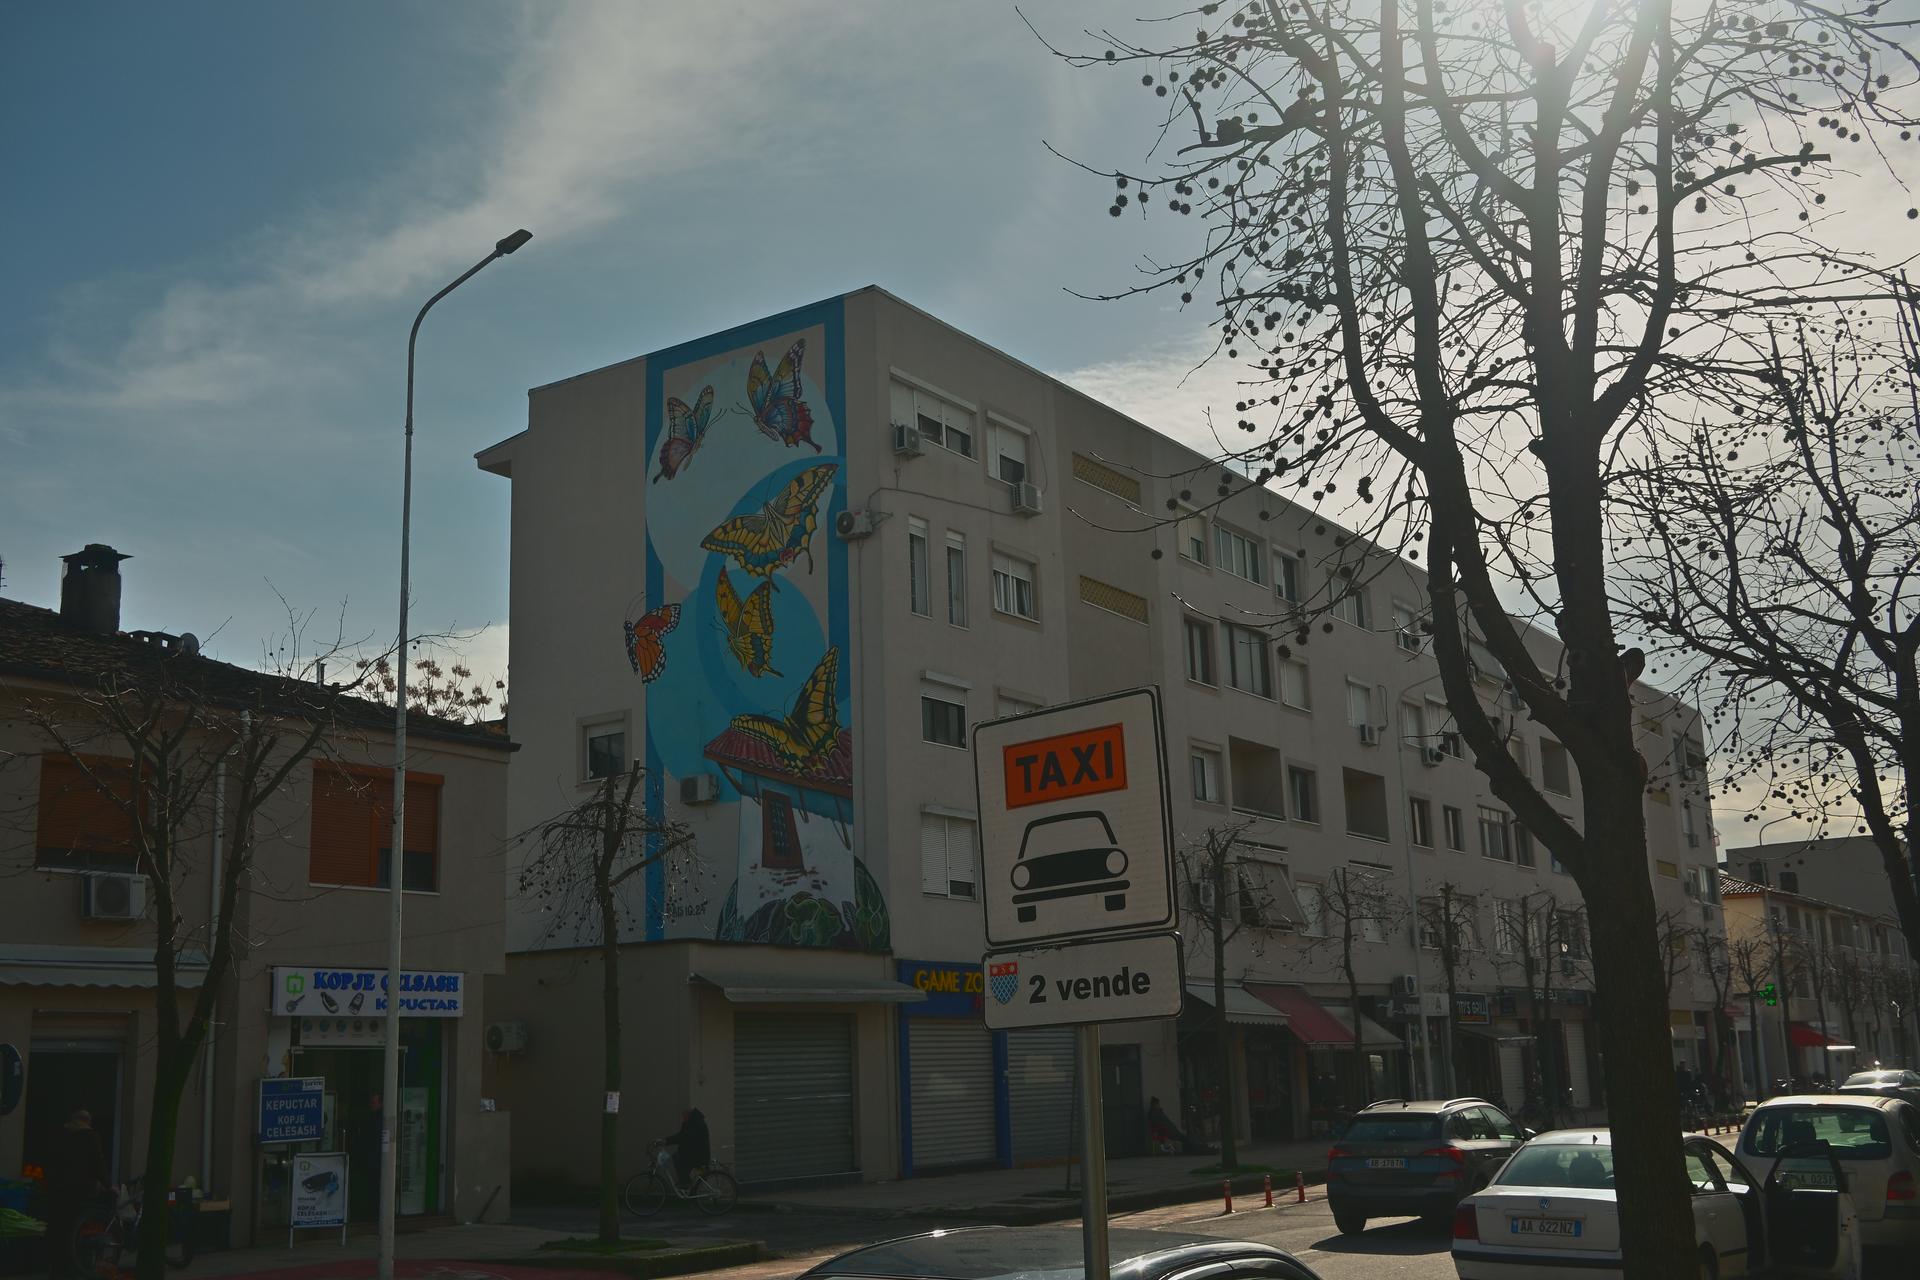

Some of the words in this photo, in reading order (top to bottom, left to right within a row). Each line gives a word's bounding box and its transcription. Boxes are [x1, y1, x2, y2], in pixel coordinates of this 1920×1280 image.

[1015, 740, 1113, 793] TAXI
[313, 971, 375, 991] KOPJE
[380, 974, 459, 996] ÇLSASH
[914, 968, 960, 993] GAME
[1029, 974, 1047, 1004] 2
[1056, 966, 1151, 1001] vende
[375, 998, 458, 1011] KPUCTAR
[265, 1097, 318, 1111] KEPUCTAR
[277, 1114, 306, 1126] KOPJE
[1520, 1219, 1533, 1233] AA
